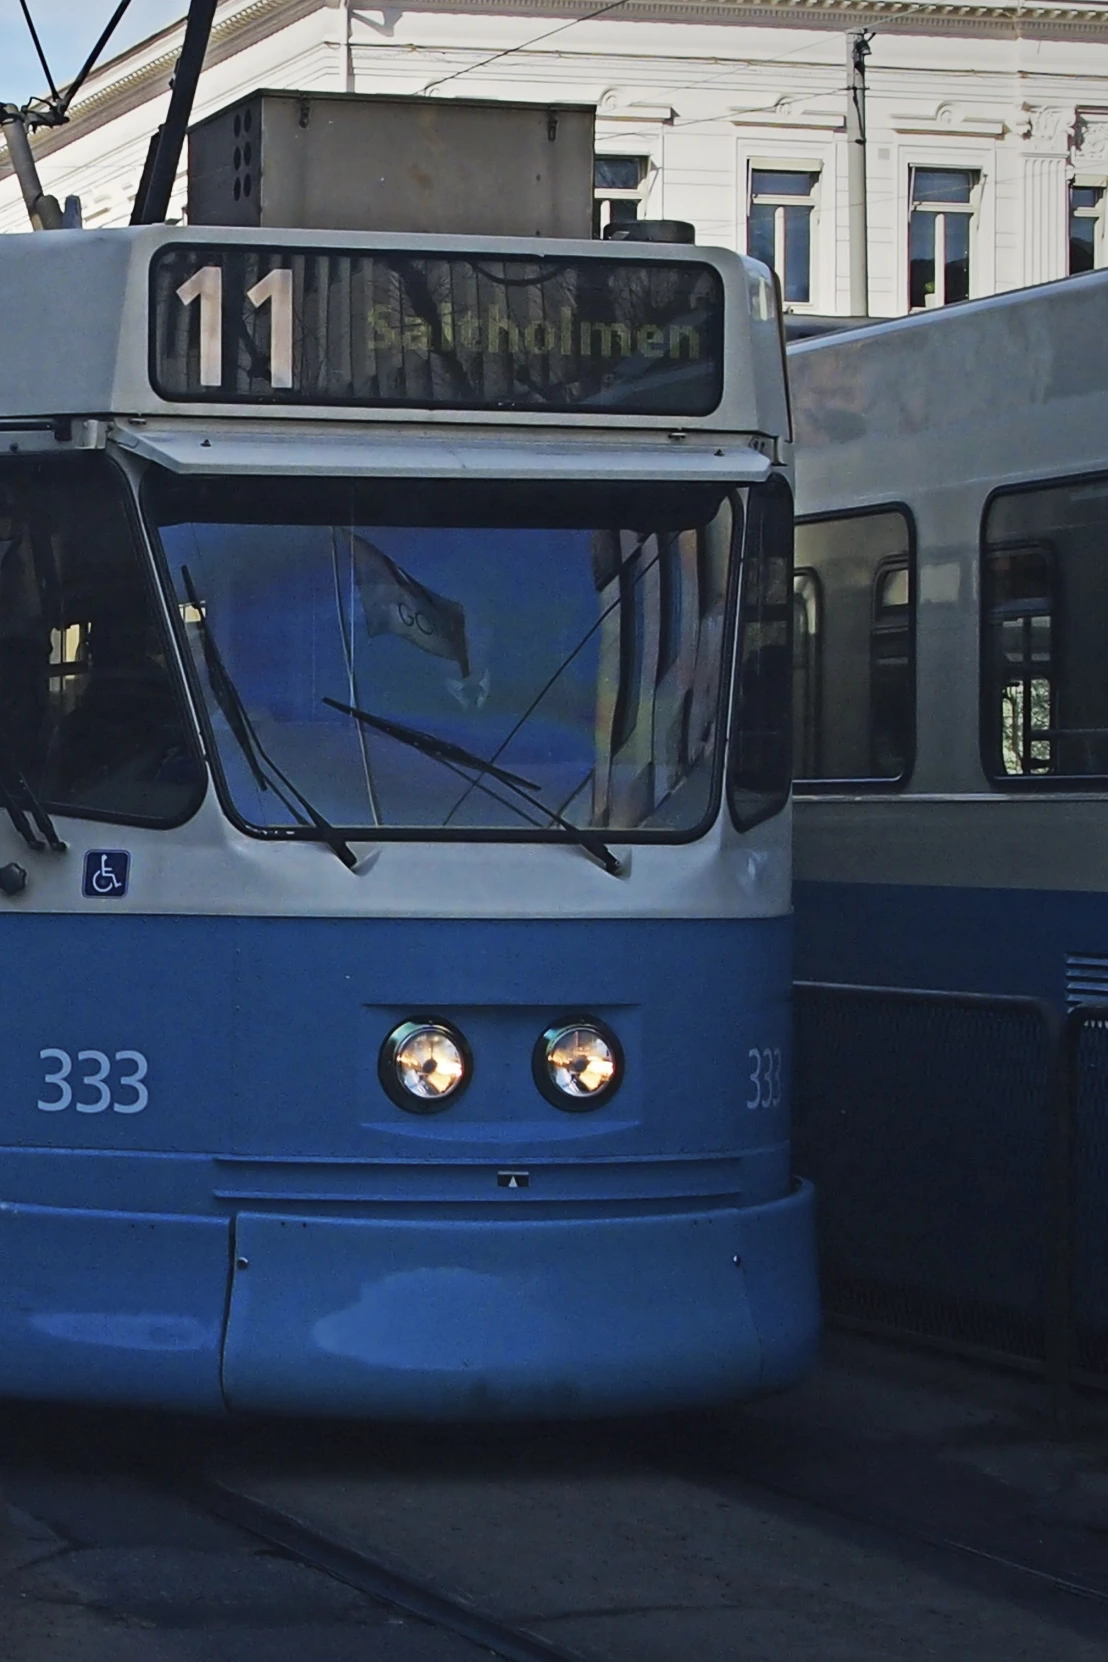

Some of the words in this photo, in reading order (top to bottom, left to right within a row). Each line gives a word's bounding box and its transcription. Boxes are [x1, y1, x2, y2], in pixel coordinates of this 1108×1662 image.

[175, 265, 294, 390] 11
[366, 303, 700, 359] Saltholmen
[36, 1047, 150, 1115] 333
[746, 1046, 783, 1110] 333
